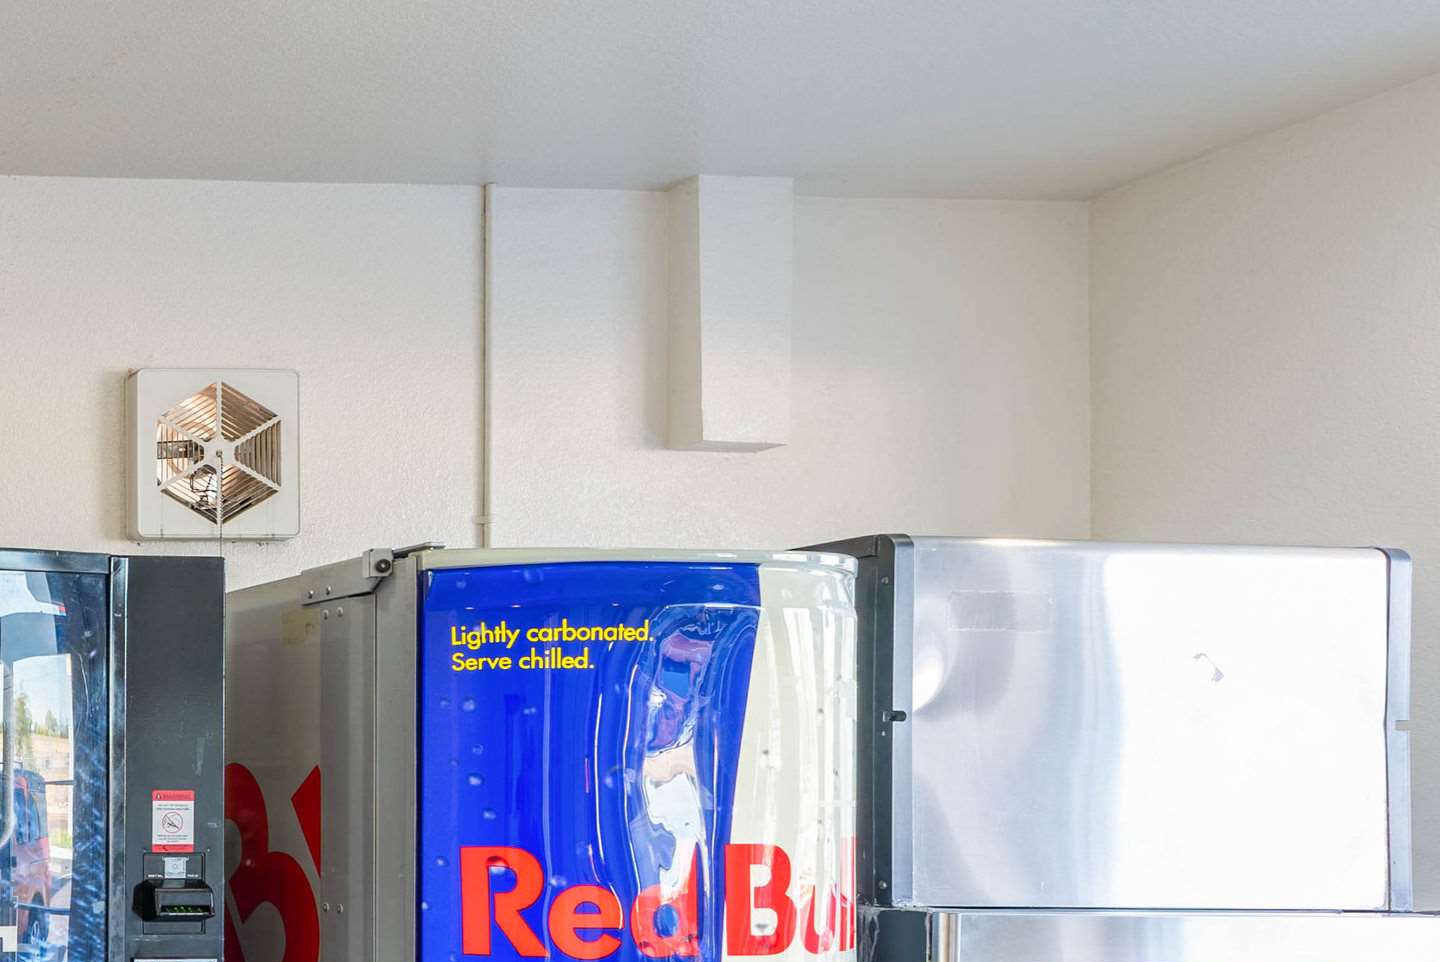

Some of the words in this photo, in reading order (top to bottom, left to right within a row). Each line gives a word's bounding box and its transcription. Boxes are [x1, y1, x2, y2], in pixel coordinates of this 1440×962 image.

[451, 620, 520, 650] Lightly
[526, 618, 654, 643] carbonated.
[451, 653, 512, 671] Serve
[519, 647, 595, 670] chilled.
[460, 841, 702, 960] Red
